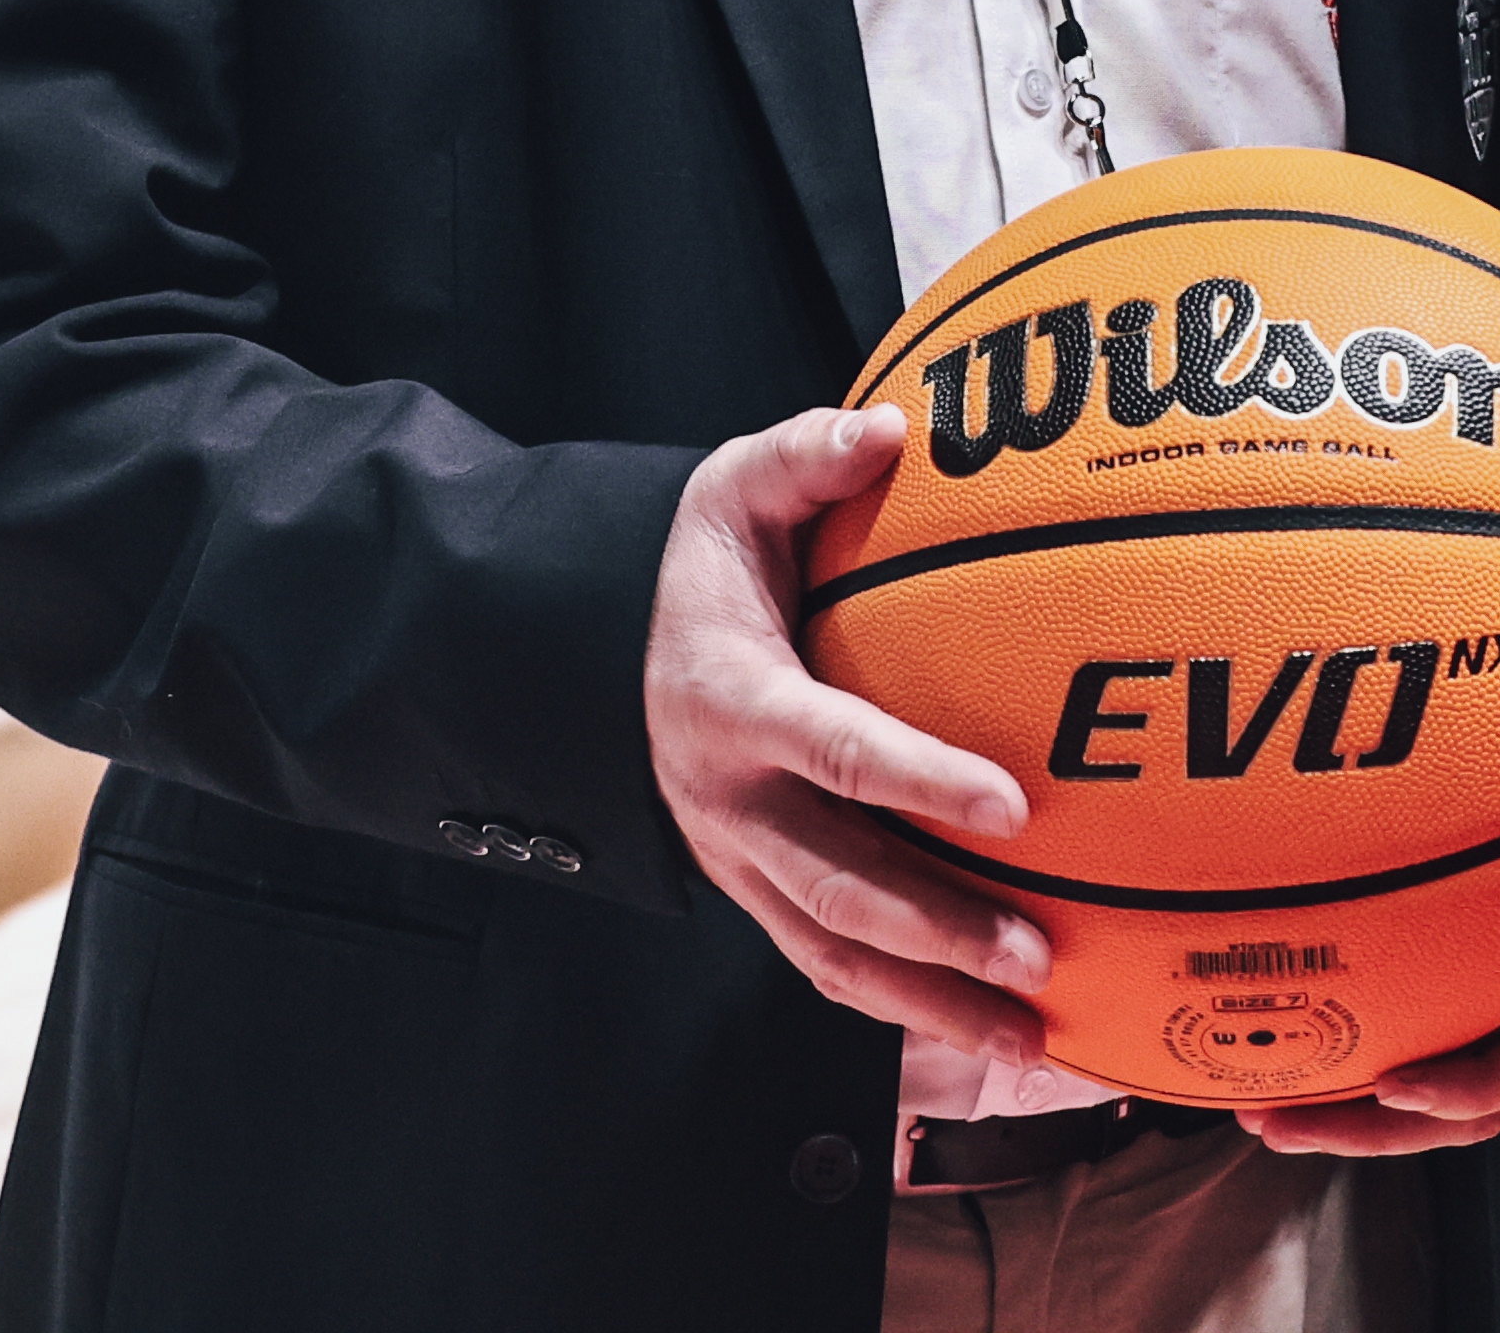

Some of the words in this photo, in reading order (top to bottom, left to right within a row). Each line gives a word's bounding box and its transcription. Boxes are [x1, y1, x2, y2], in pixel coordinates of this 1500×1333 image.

[1087, 442, 1204, 474] INDOOR
[1219, 439, 1308, 456] GAME
[1323, 442, 1397, 462] BALL
[1047, 641, 1439, 781] EVO
